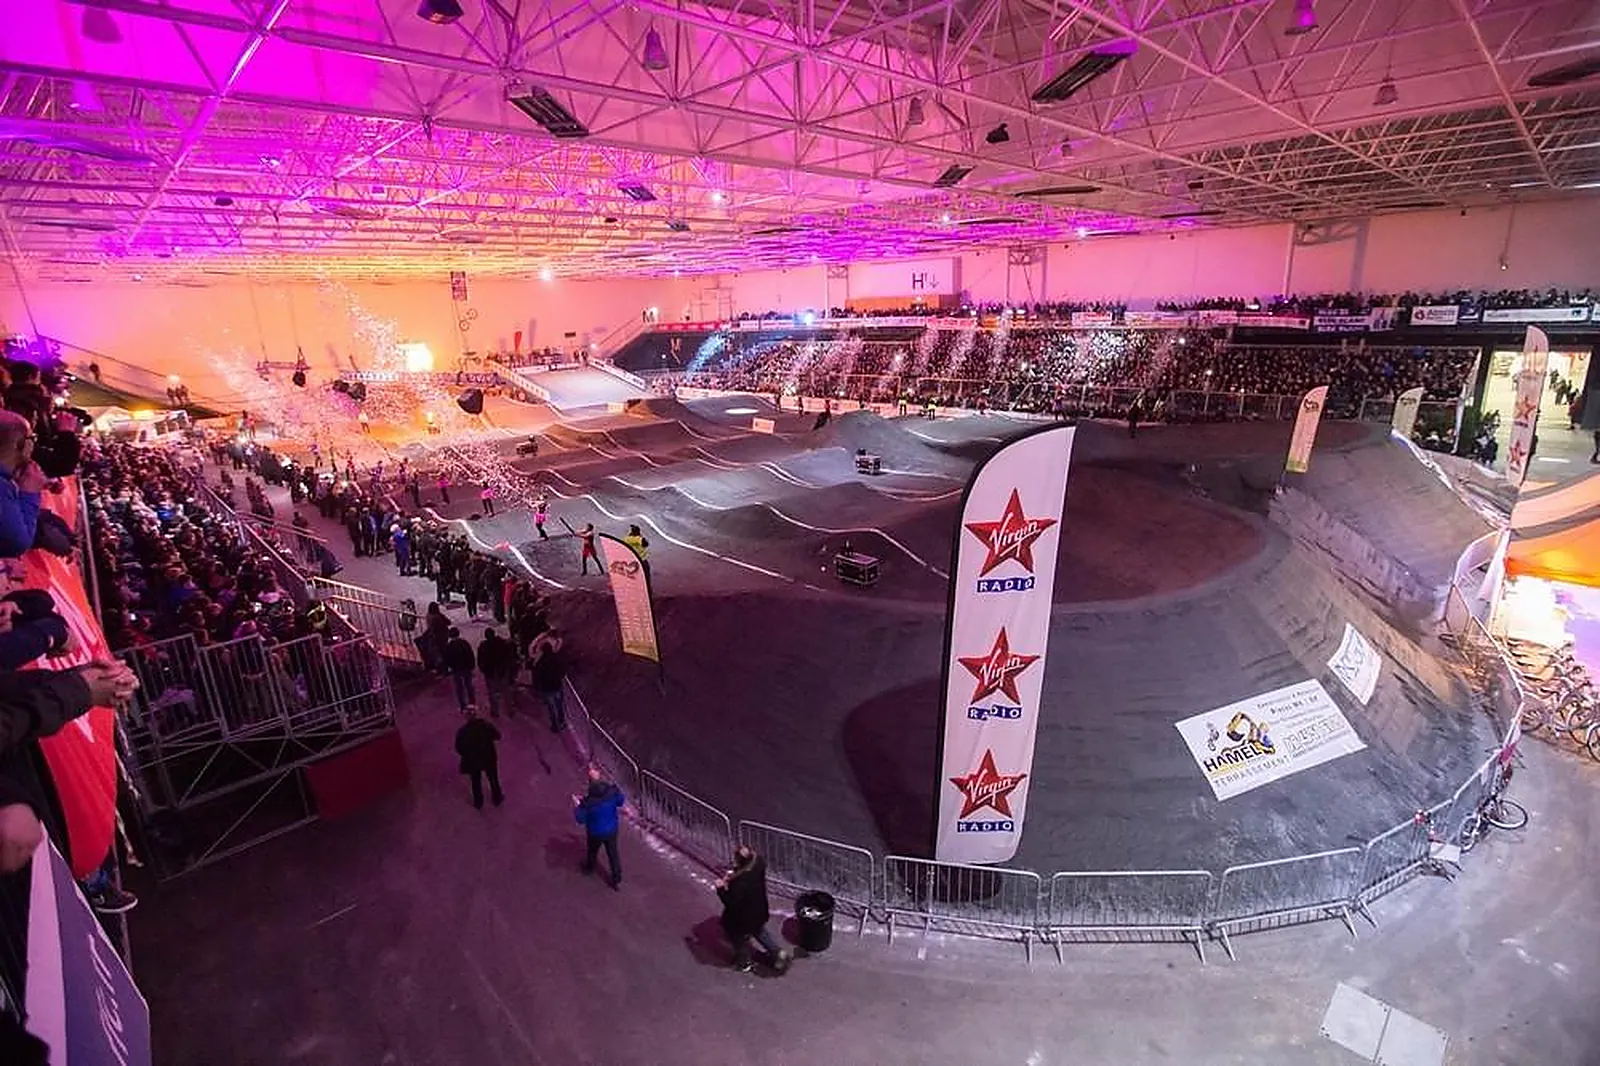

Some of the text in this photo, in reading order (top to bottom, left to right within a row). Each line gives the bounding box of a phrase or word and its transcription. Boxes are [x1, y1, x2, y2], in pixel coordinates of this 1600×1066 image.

[989, 512, 1042, 558] Virgin
[979, 578, 1034, 592] RADIO
[970, 706, 1020, 719] RADIO
[1203, 744, 1262, 772] HAMEL
[967, 769, 1014, 807] Virgin
[959, 821, 1013, 833] RADIO
